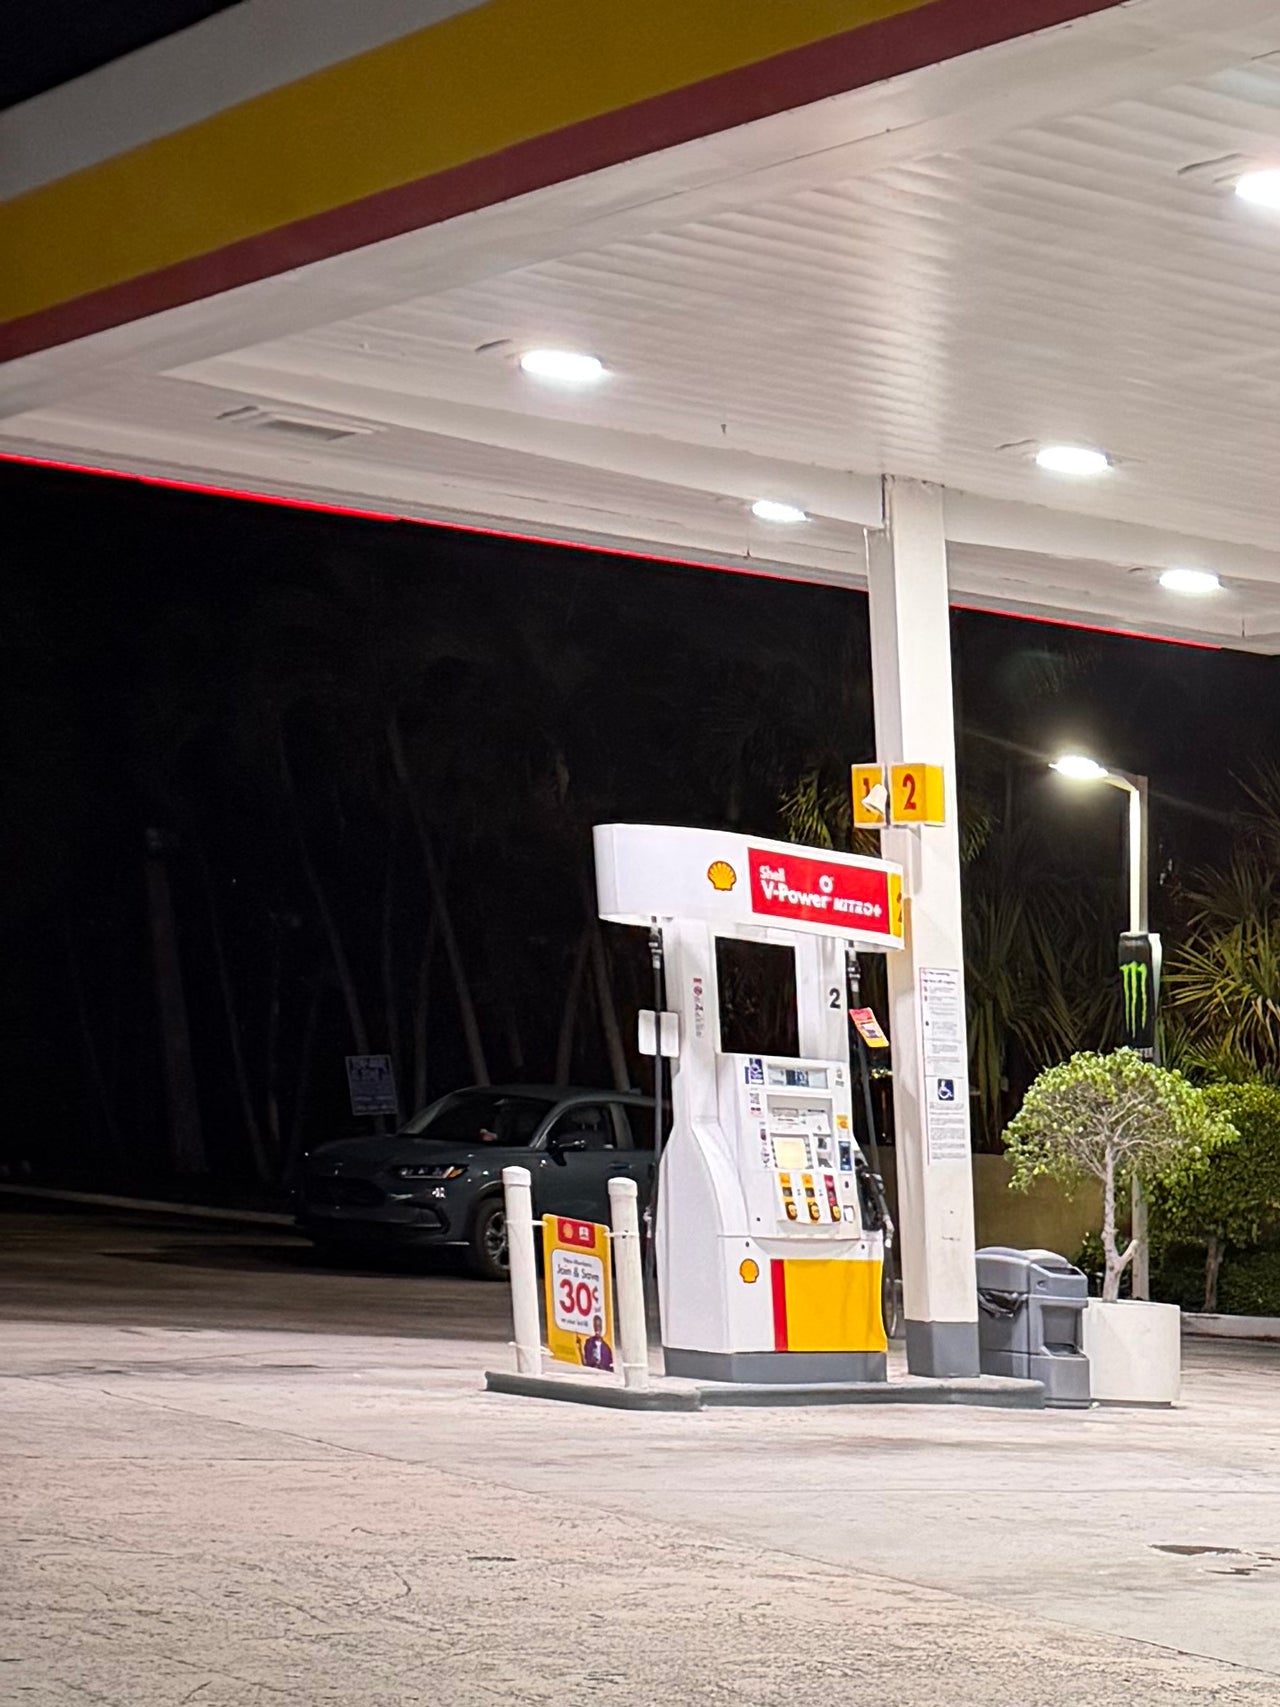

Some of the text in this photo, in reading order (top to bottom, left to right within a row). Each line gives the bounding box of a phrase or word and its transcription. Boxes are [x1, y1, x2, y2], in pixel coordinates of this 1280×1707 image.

[902, 773, 917, 810] 2
[759, 865, 786, 882] Shell
[760, 880, 832, 909] V-Power
[829, 988, 841, 1009] 2
[557, 1264, 572, 1276] Join
